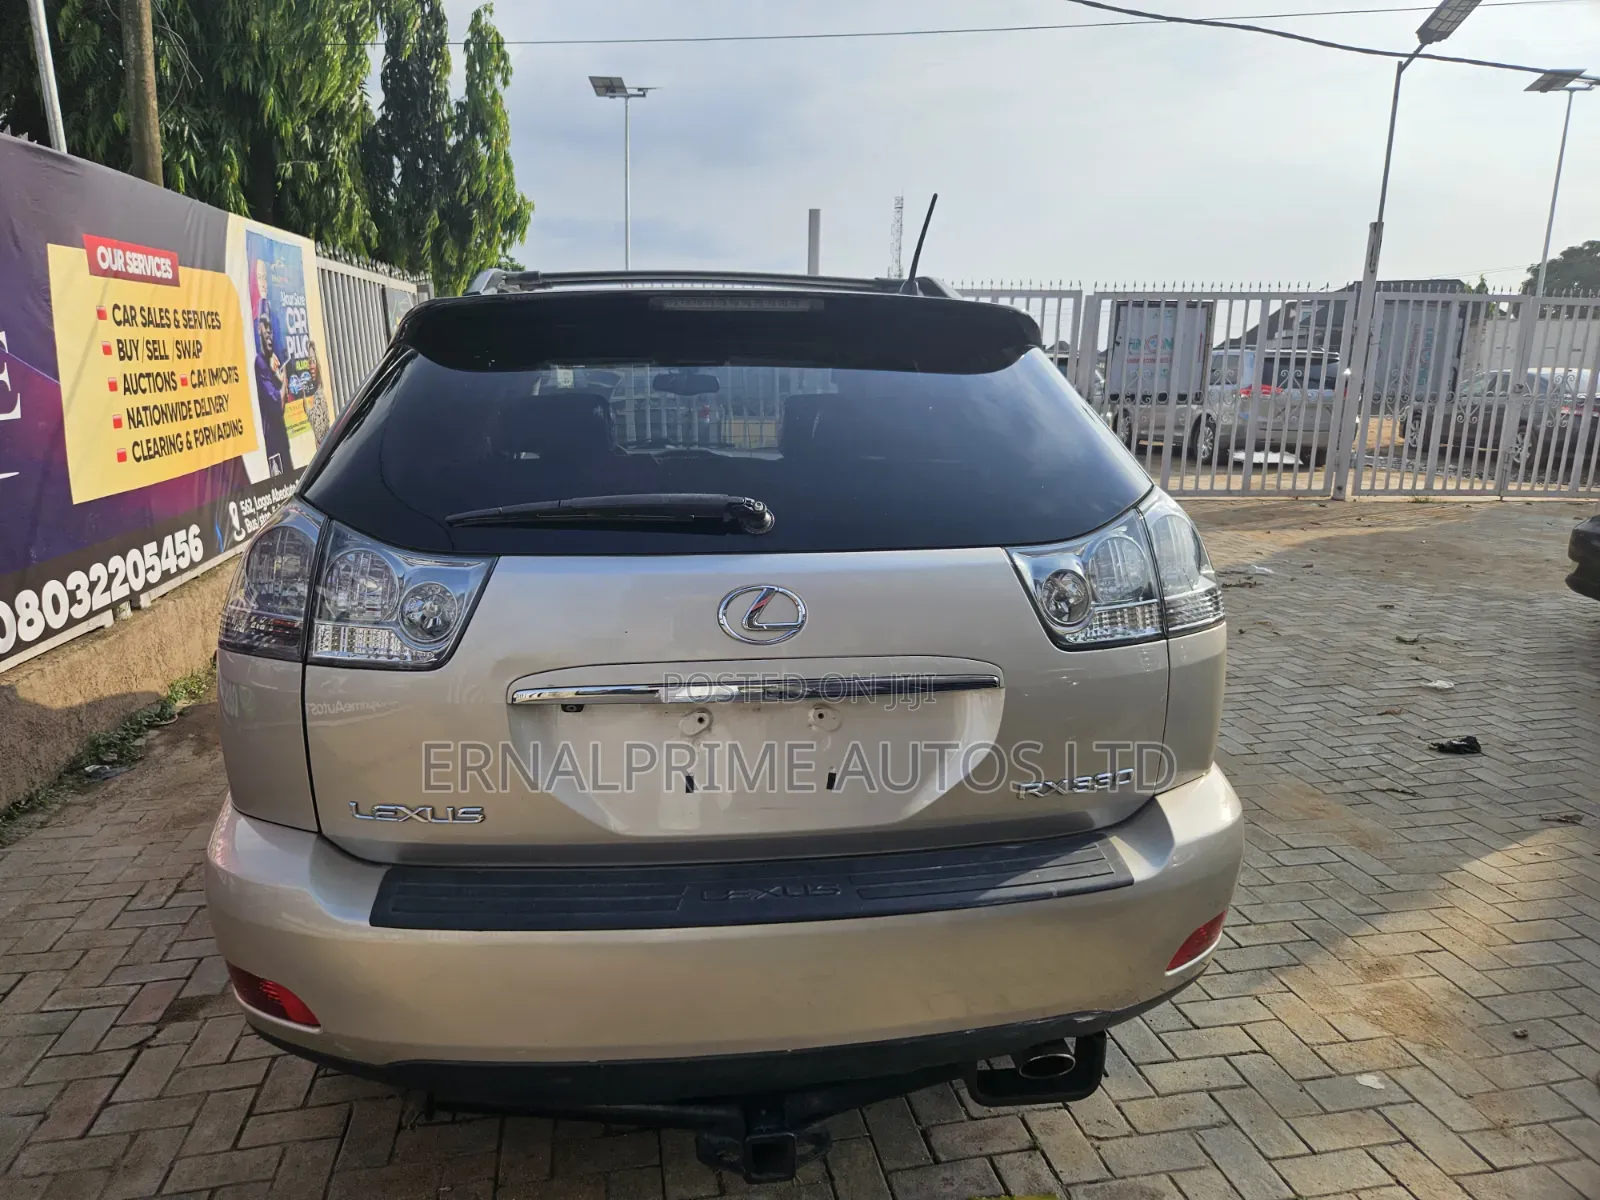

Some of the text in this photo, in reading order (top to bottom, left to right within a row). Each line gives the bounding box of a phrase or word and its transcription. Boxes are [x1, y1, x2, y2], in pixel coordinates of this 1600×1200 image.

[96, 245, 173, 279] OUR SERVICES
[112, 303, 222, 330] CAR SALES & SERVICES
[285, 306, 309, 334] CAR
[123, 365, 240, 396] AUCTIONS CAR IMPORTS
[126, 394, 230, 430] NATIONWIDE DELIVERY
[131, 418, 244, 463] CLEARING & FORWARDING
[253, 493, 273, 511] Lagos
[0, 524, 204, 654] 08032205456
[349, 801, 486, 824] LEXUS
[701, 884, 841, 902] LEXUS
